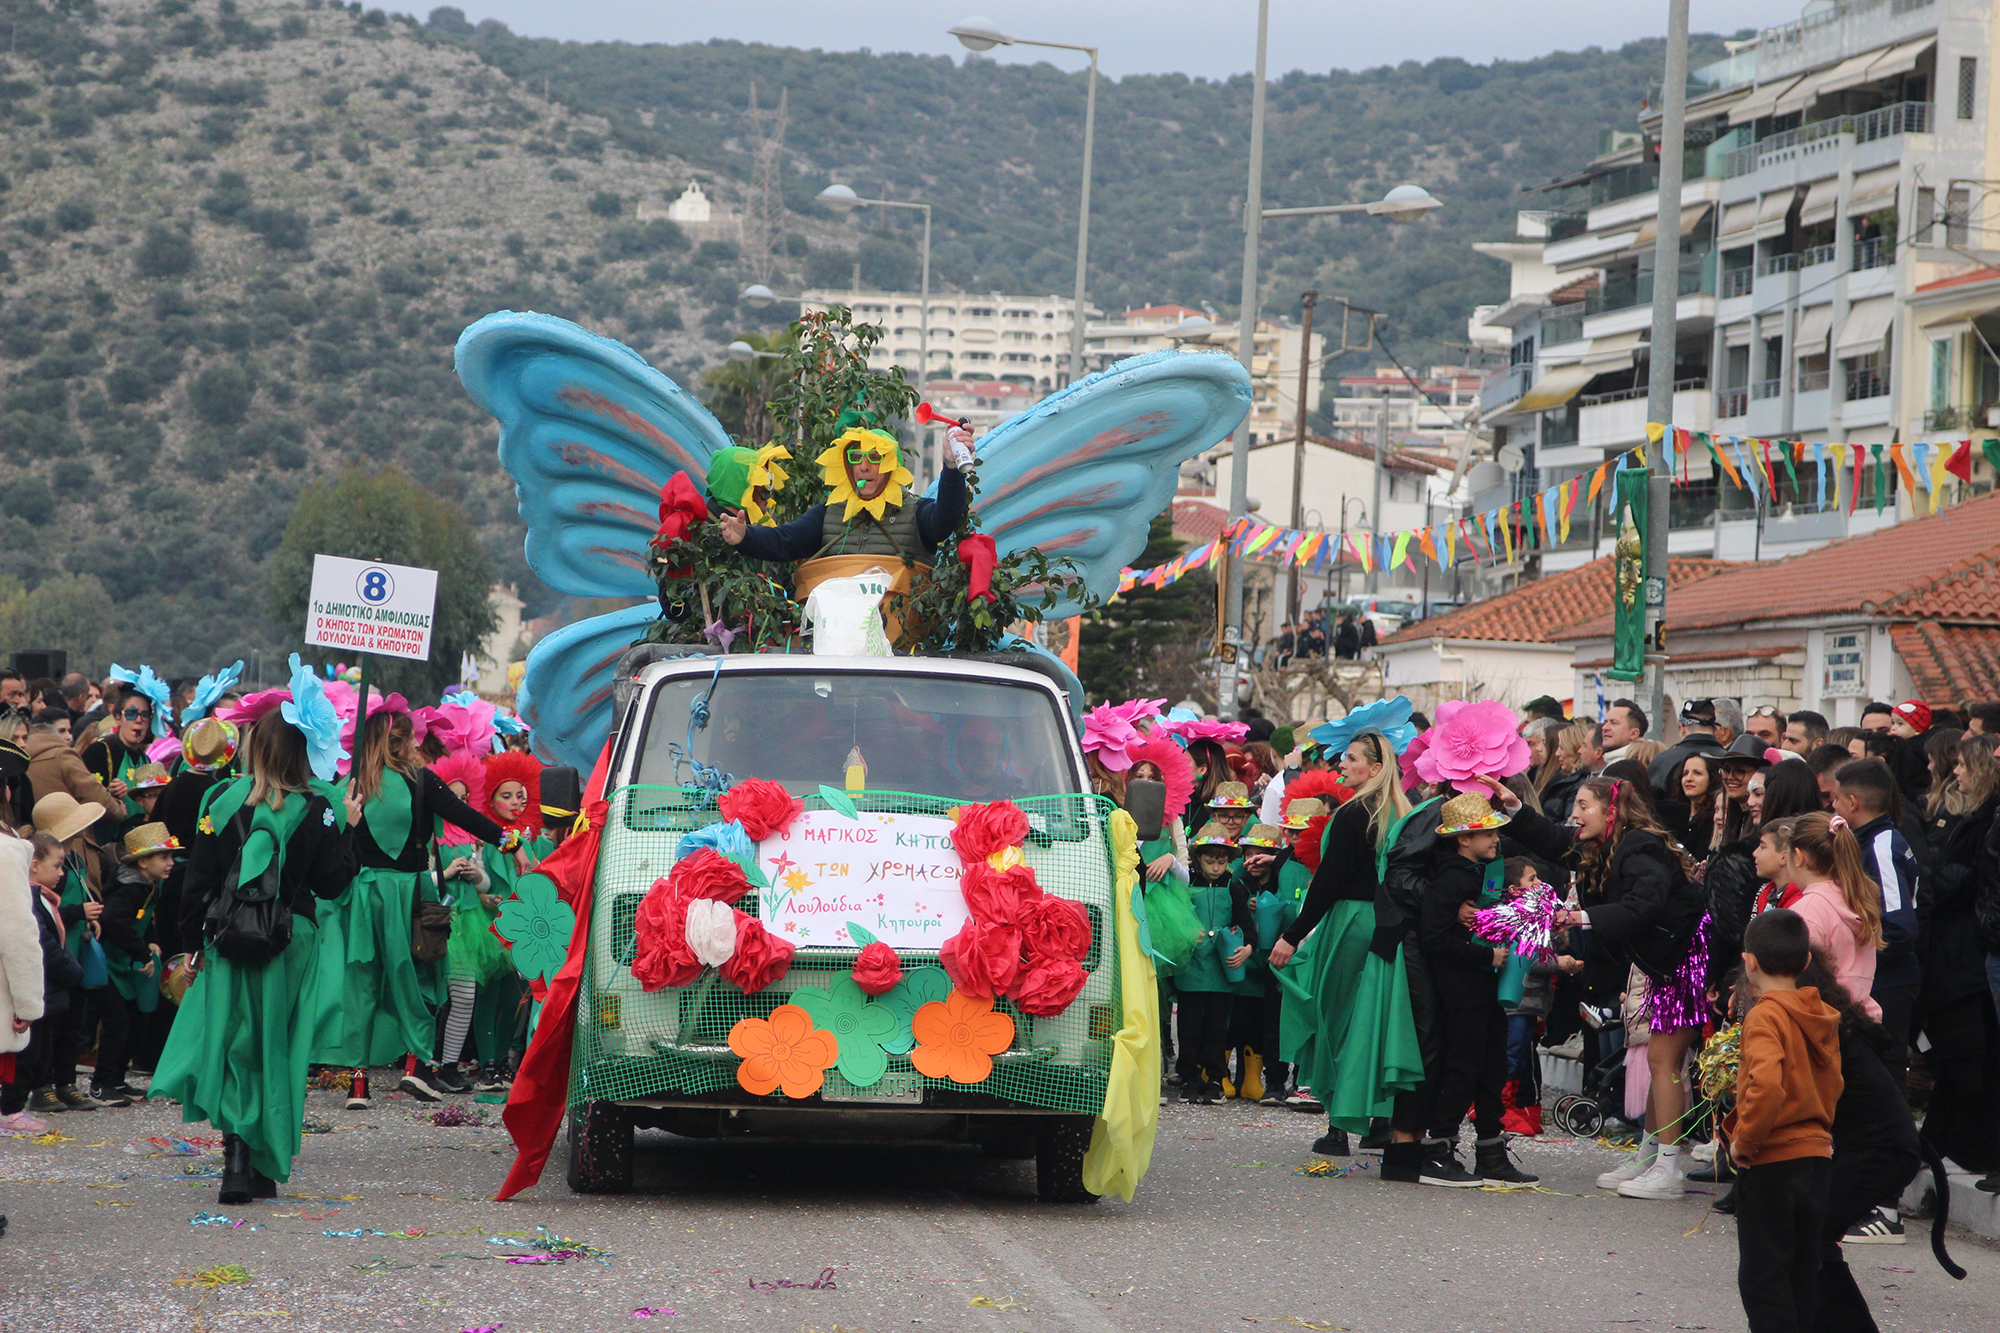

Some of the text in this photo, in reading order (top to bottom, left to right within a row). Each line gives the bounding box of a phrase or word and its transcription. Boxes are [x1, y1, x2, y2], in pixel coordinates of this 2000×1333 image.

[363, 571, 387, 602] 8
[325, 601, 373, 621] ΔΗΜΟΤΙΚΟ
[374, 608, 431, 629] ΑΜΦΙΛΟΧΙΑΣ
[316, 617, 424, 642] Ο ΚΗΠΟΣ ΤΩΝ ΧΡΩΜΑΤΩΝ
[316, 630, 422, 655] ΛΟΥΛΟΥΔΙΑ & ΚΗΠΟΥΡΟΙ
[804, 827, 879, 845] ΜΑΓΙΚΟΣ
[895, 832, 957, 851] ΚΗΠΟ
[814, 862, 850, 878] ΤΩΝ
[784, 894, 863, 915] Λουλούδια
